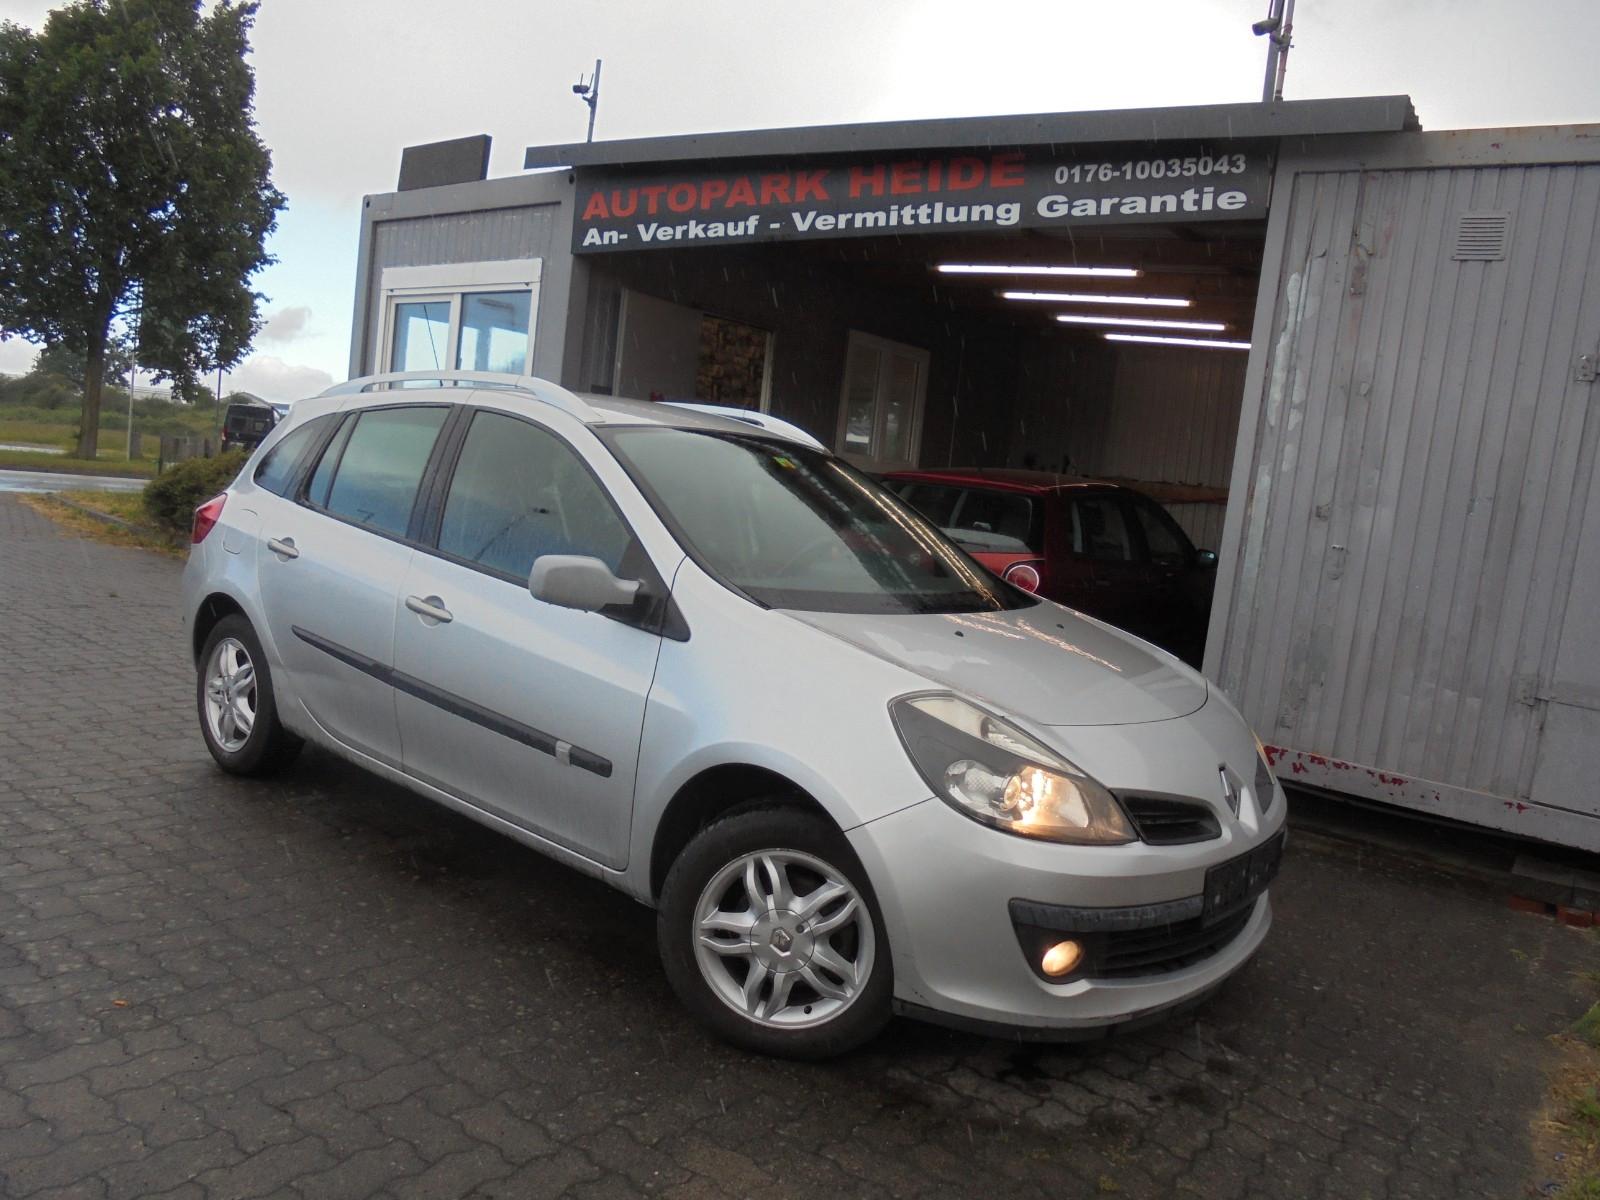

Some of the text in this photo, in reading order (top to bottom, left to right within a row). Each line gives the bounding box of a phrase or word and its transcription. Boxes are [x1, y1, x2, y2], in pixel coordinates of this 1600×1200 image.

[582, 152, 1025, 221] AUTOPARK HEIDE
[1054, 154, 1247, 185] 0176-10035043
[582, 228, 628, 247] An-
[636, 214, 760, 242] Verkauf
[791, 202, 1021, 232] Vermittlung
[1036, 186, 1248, 218] Garantie
